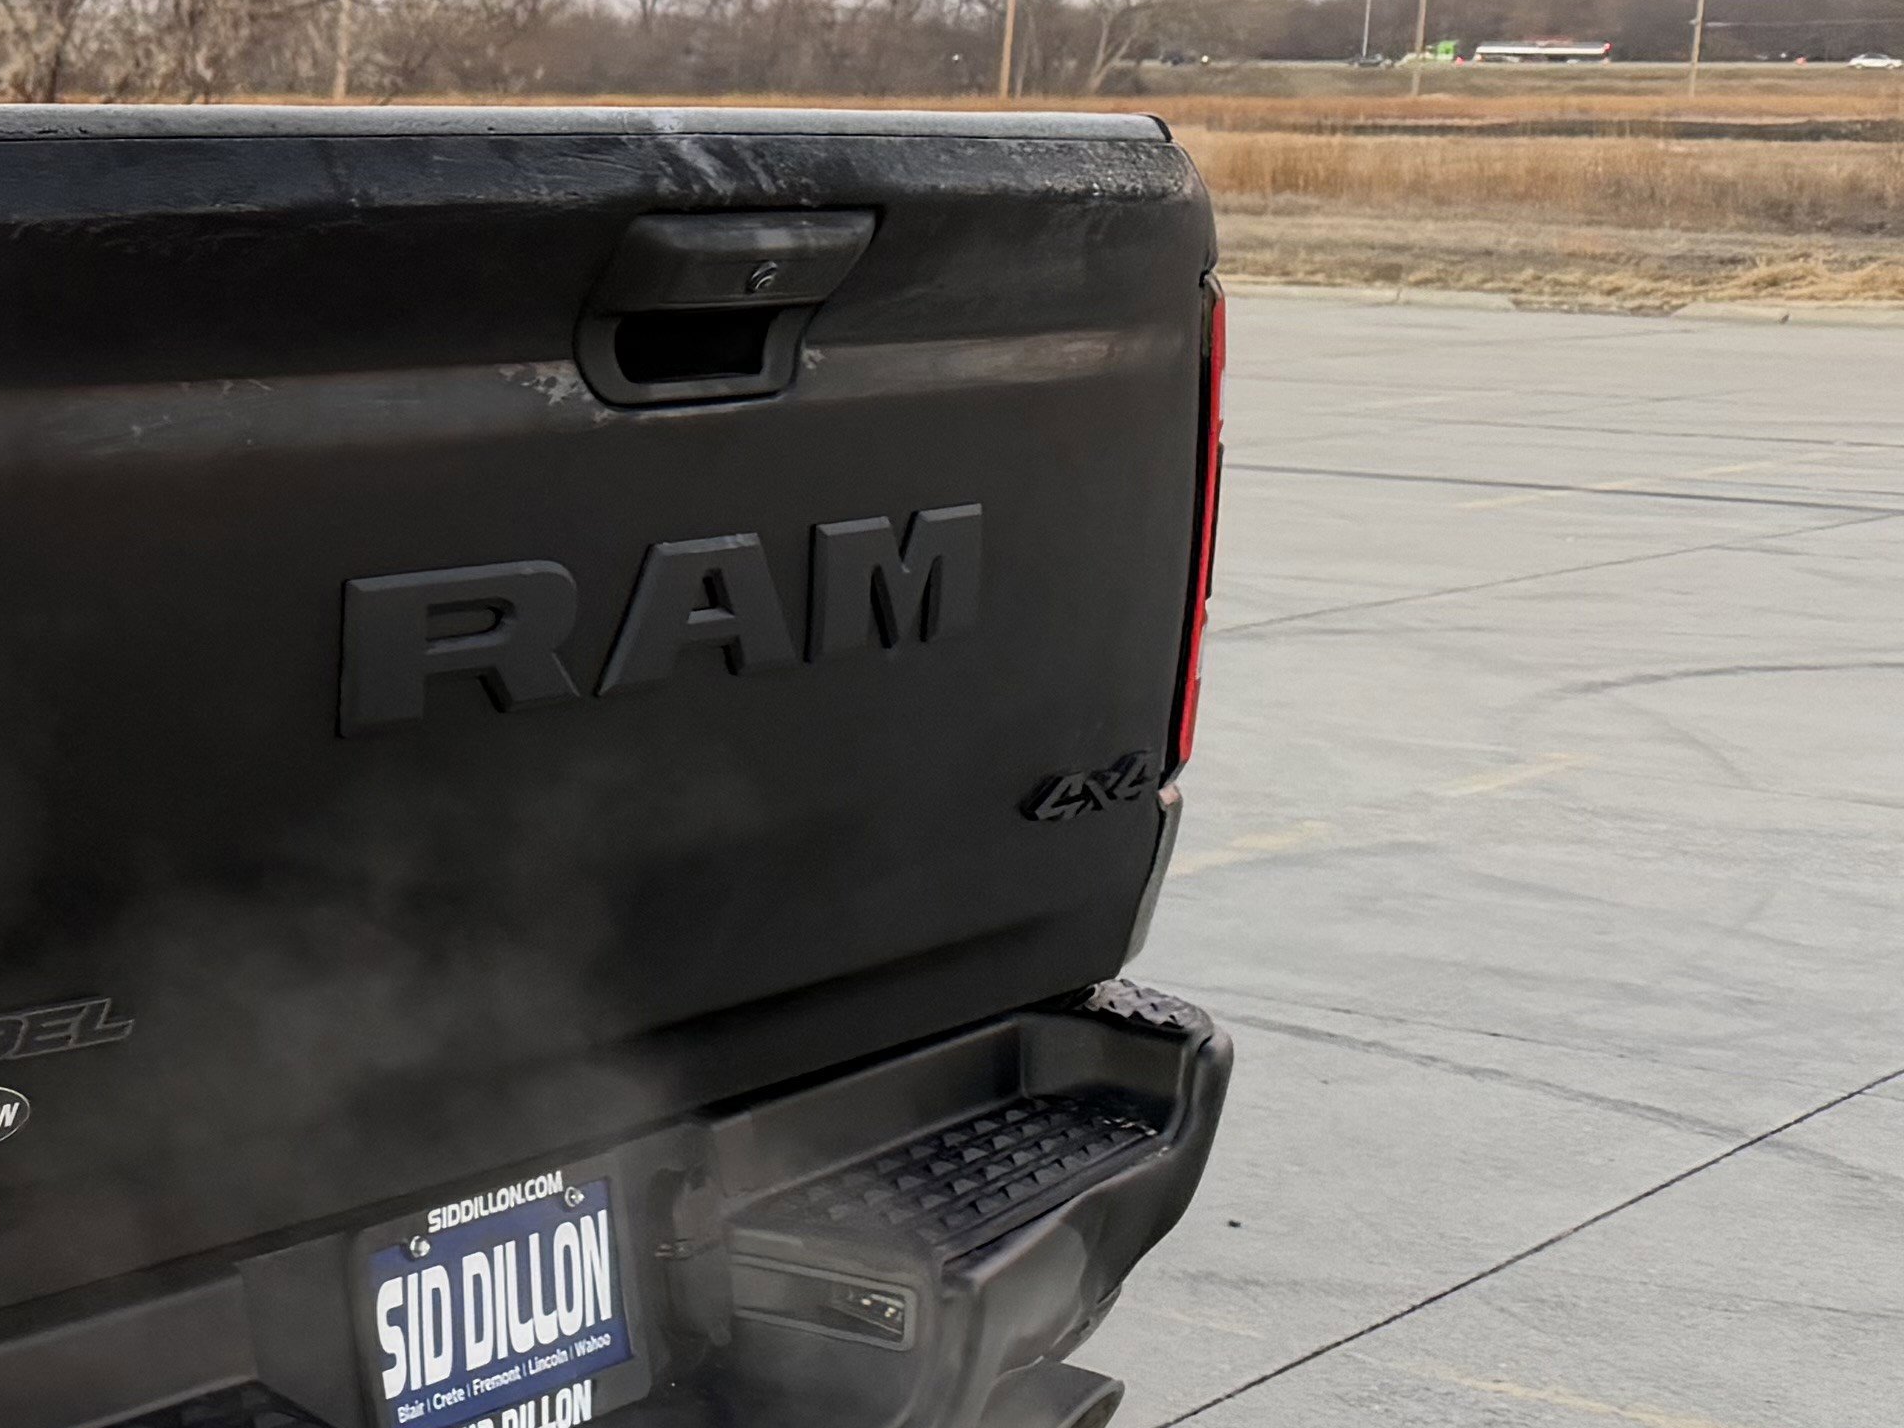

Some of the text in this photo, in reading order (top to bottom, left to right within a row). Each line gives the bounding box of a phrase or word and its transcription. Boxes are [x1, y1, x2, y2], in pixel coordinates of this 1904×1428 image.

[336, 502, 984, 738] RAM
[427, 1170, 565, 1234] SIDDILLON.COM
[376, 1208, 613, 1401] SID DILLON
[397, 1333, 612, 1424] Blair Crete Fremont Lincoln Wahoo
